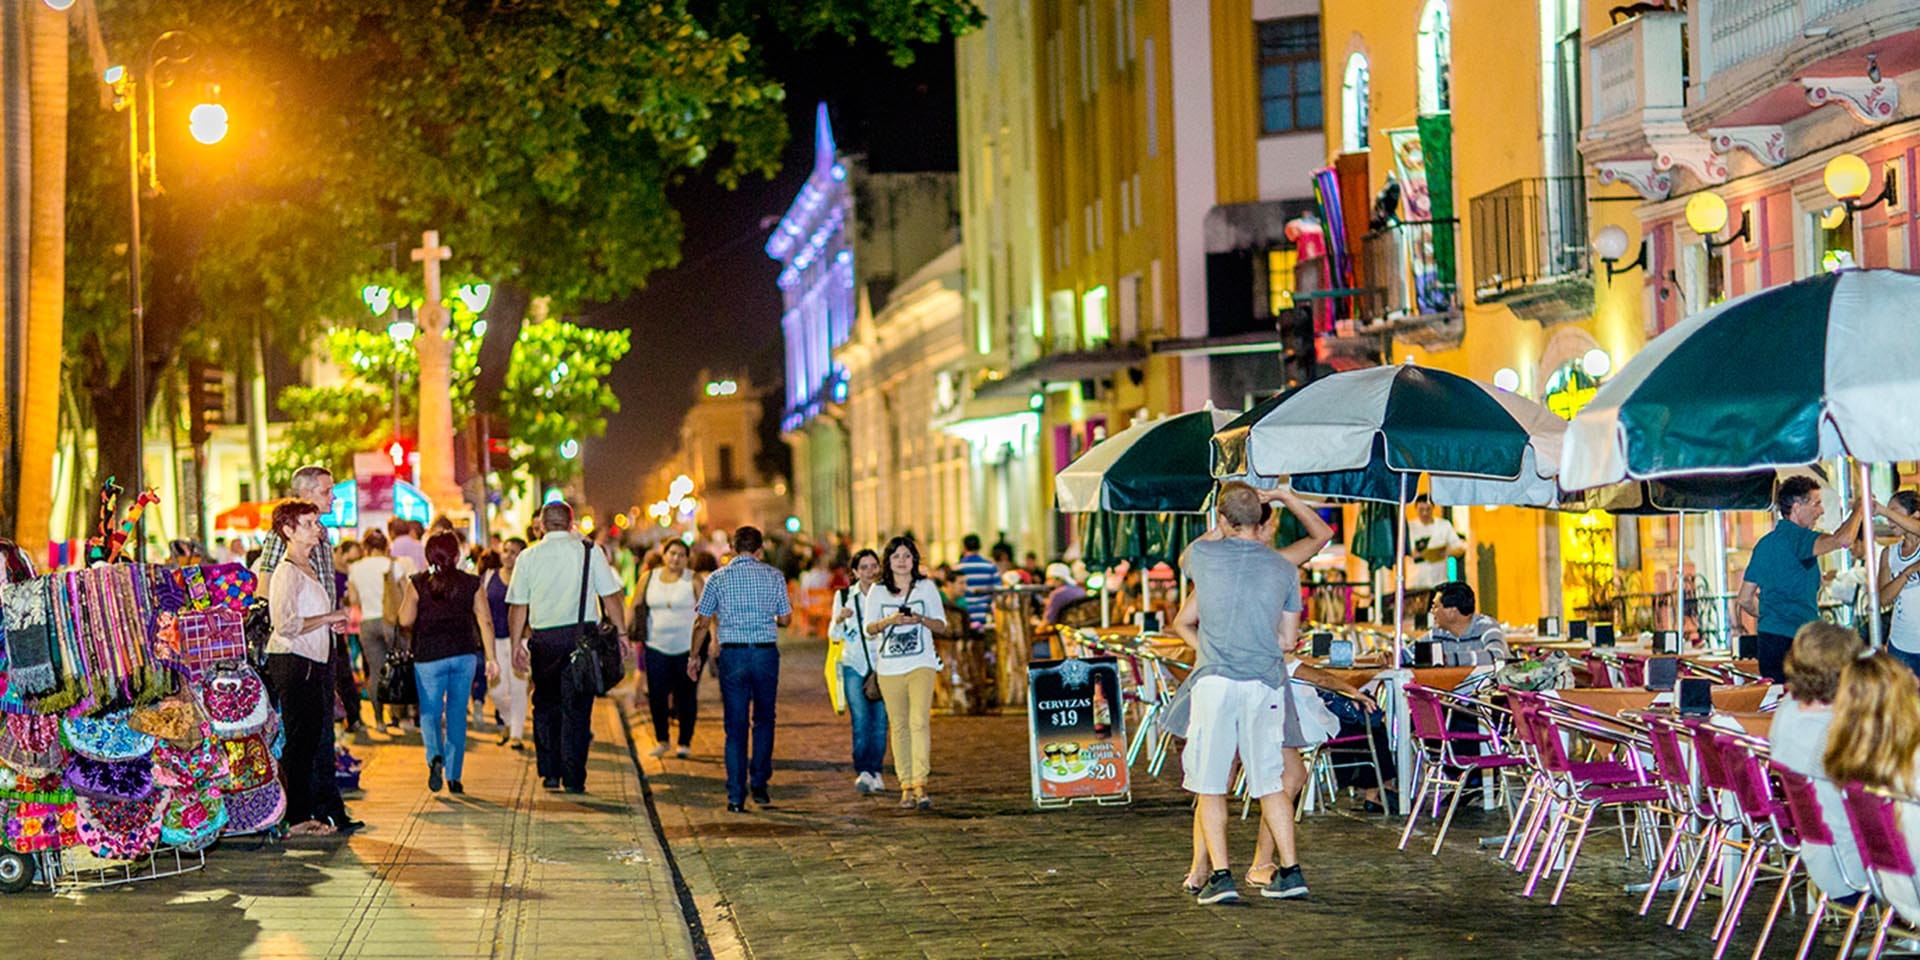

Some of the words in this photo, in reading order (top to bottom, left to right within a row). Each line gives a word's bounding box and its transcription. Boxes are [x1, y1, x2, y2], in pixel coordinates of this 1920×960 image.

[1038, 698, 1091, 710] CERVEZAS
[1051, 710, 1078, 727] $19
[1088, 763, 1117, 780] $20
